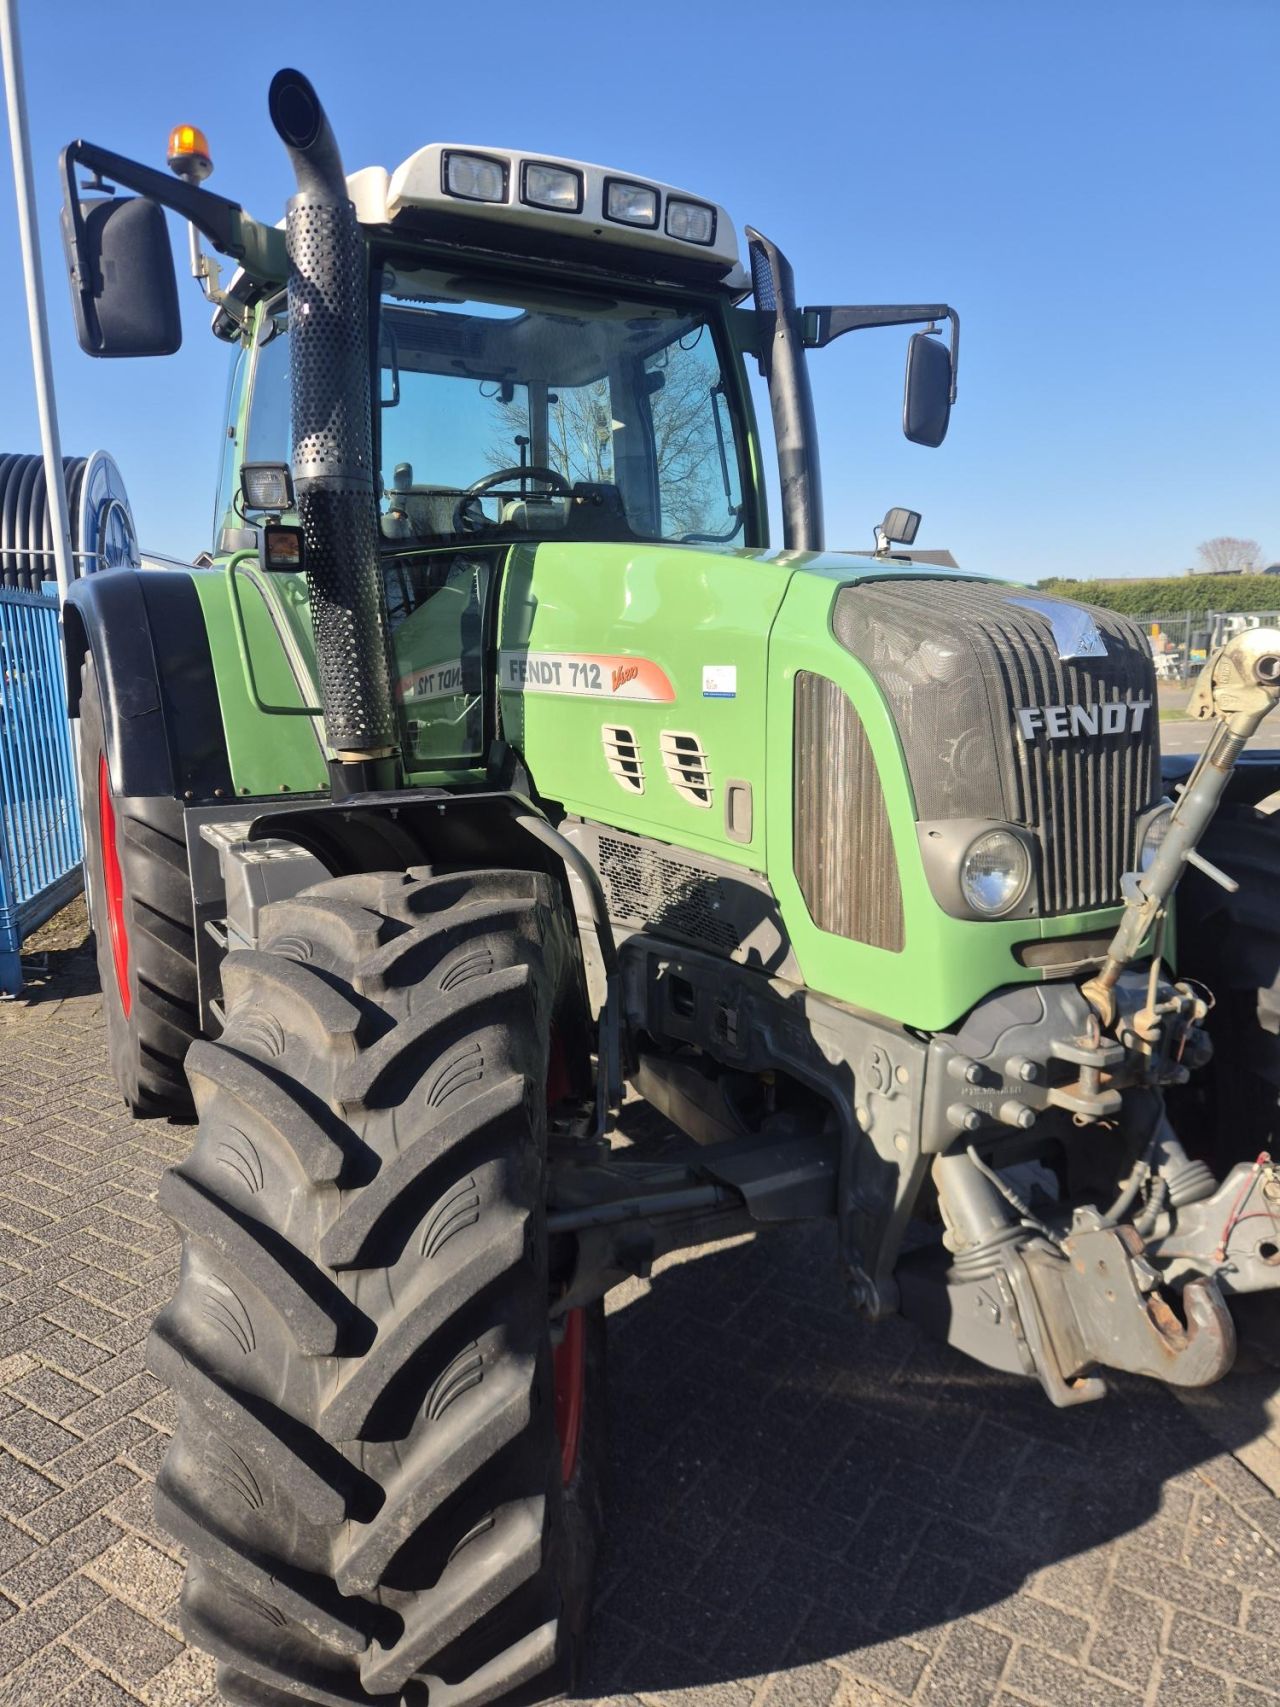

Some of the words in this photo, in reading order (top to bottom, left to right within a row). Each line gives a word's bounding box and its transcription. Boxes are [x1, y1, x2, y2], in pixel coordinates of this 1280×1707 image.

[509, 660, 562, 686] FENDT
[568, 662, 602, 689] 712
[1014, 700, 1151, 740] FENDT
